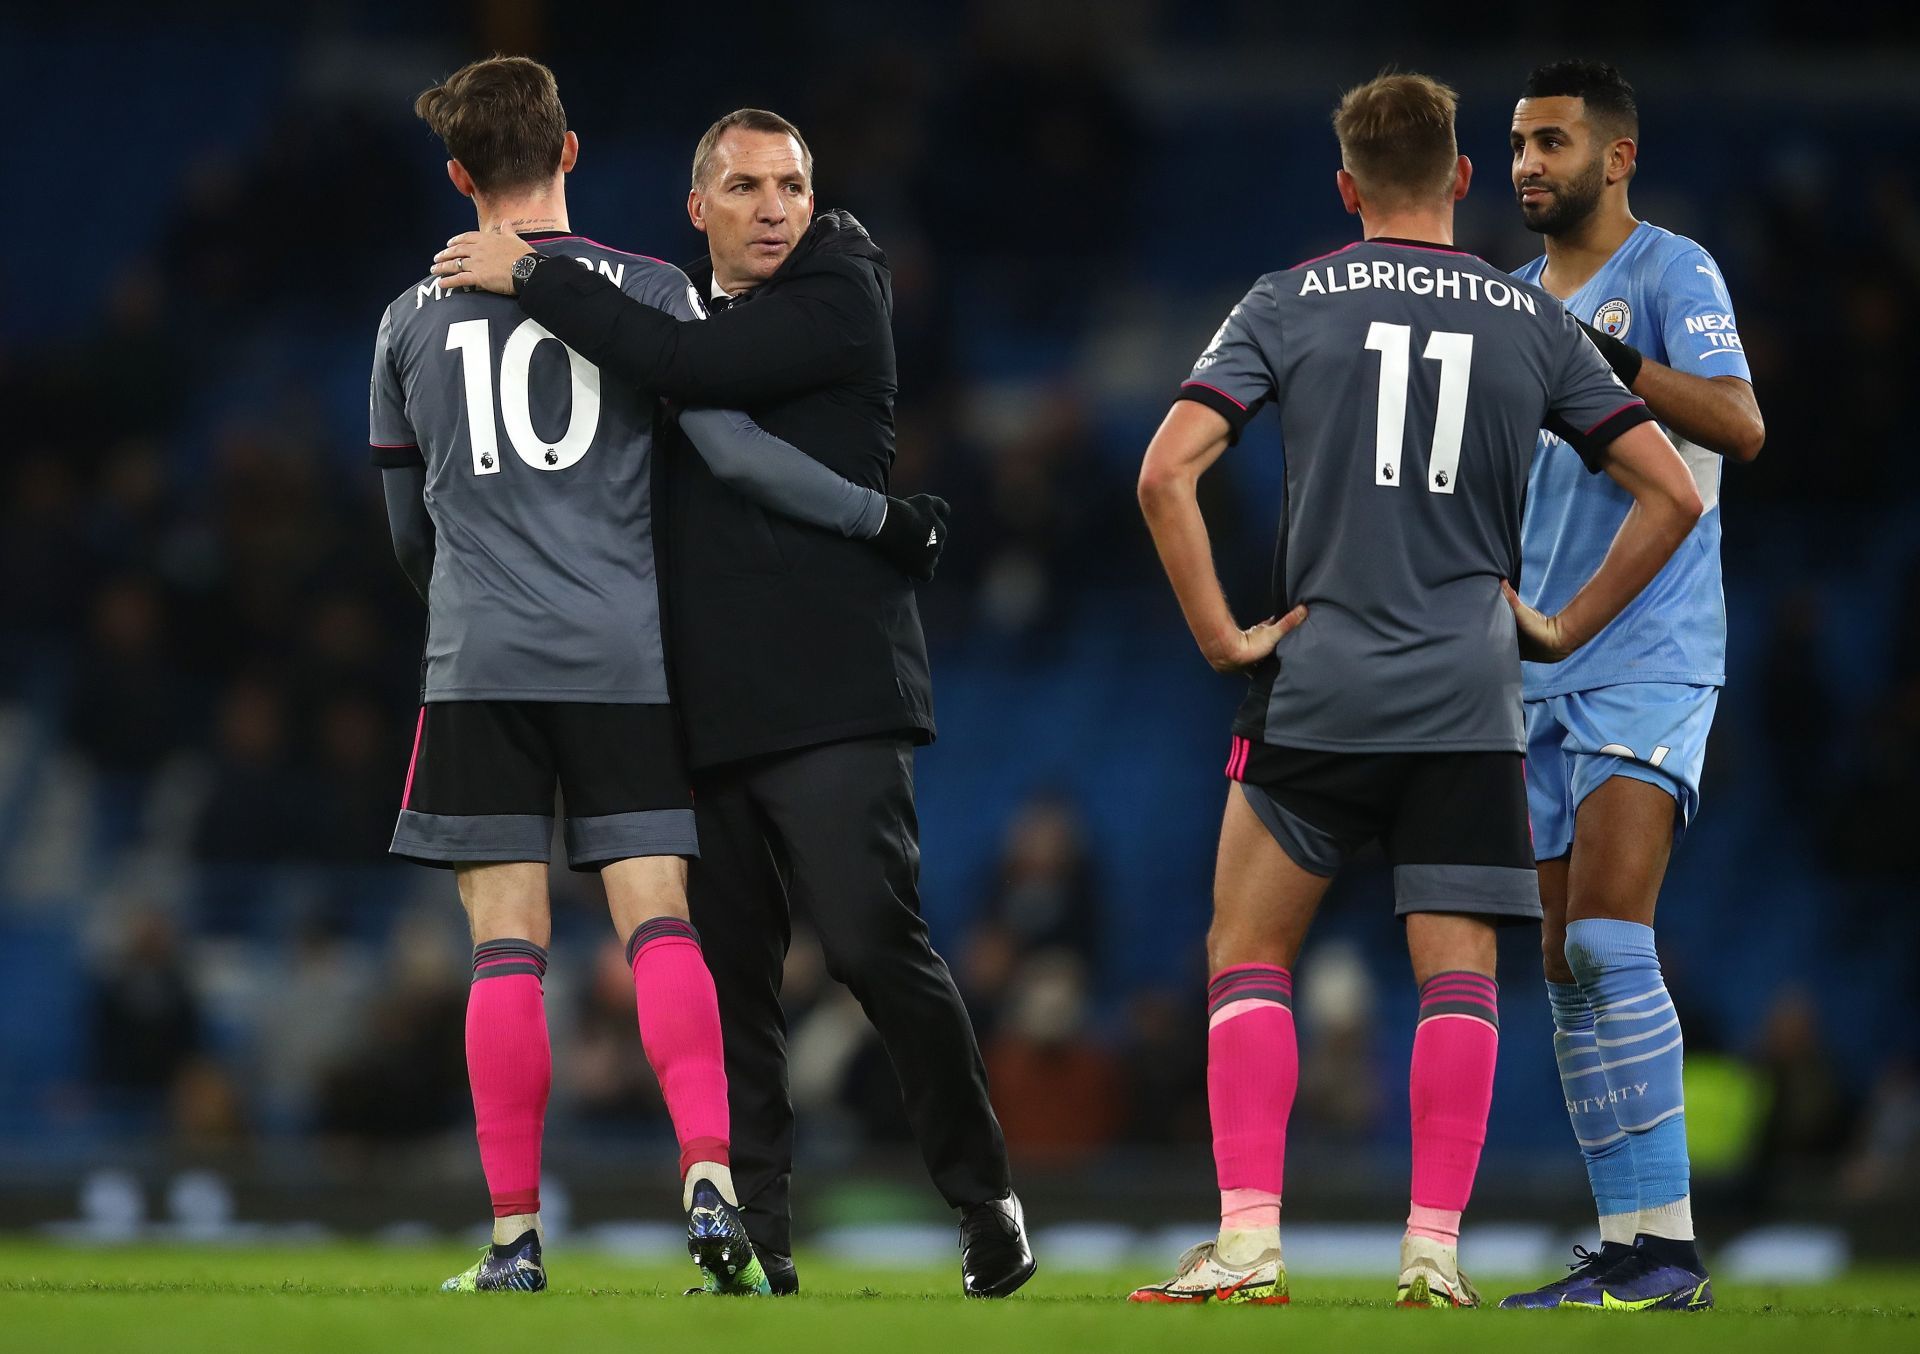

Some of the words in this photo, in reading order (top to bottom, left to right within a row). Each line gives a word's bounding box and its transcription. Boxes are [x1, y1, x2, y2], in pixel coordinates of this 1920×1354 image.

[1298, 261, 1536, 315] ALBRIGHTON
[445, 318, 600, 476] 10
[1364, 321, 1474, 494] 11
